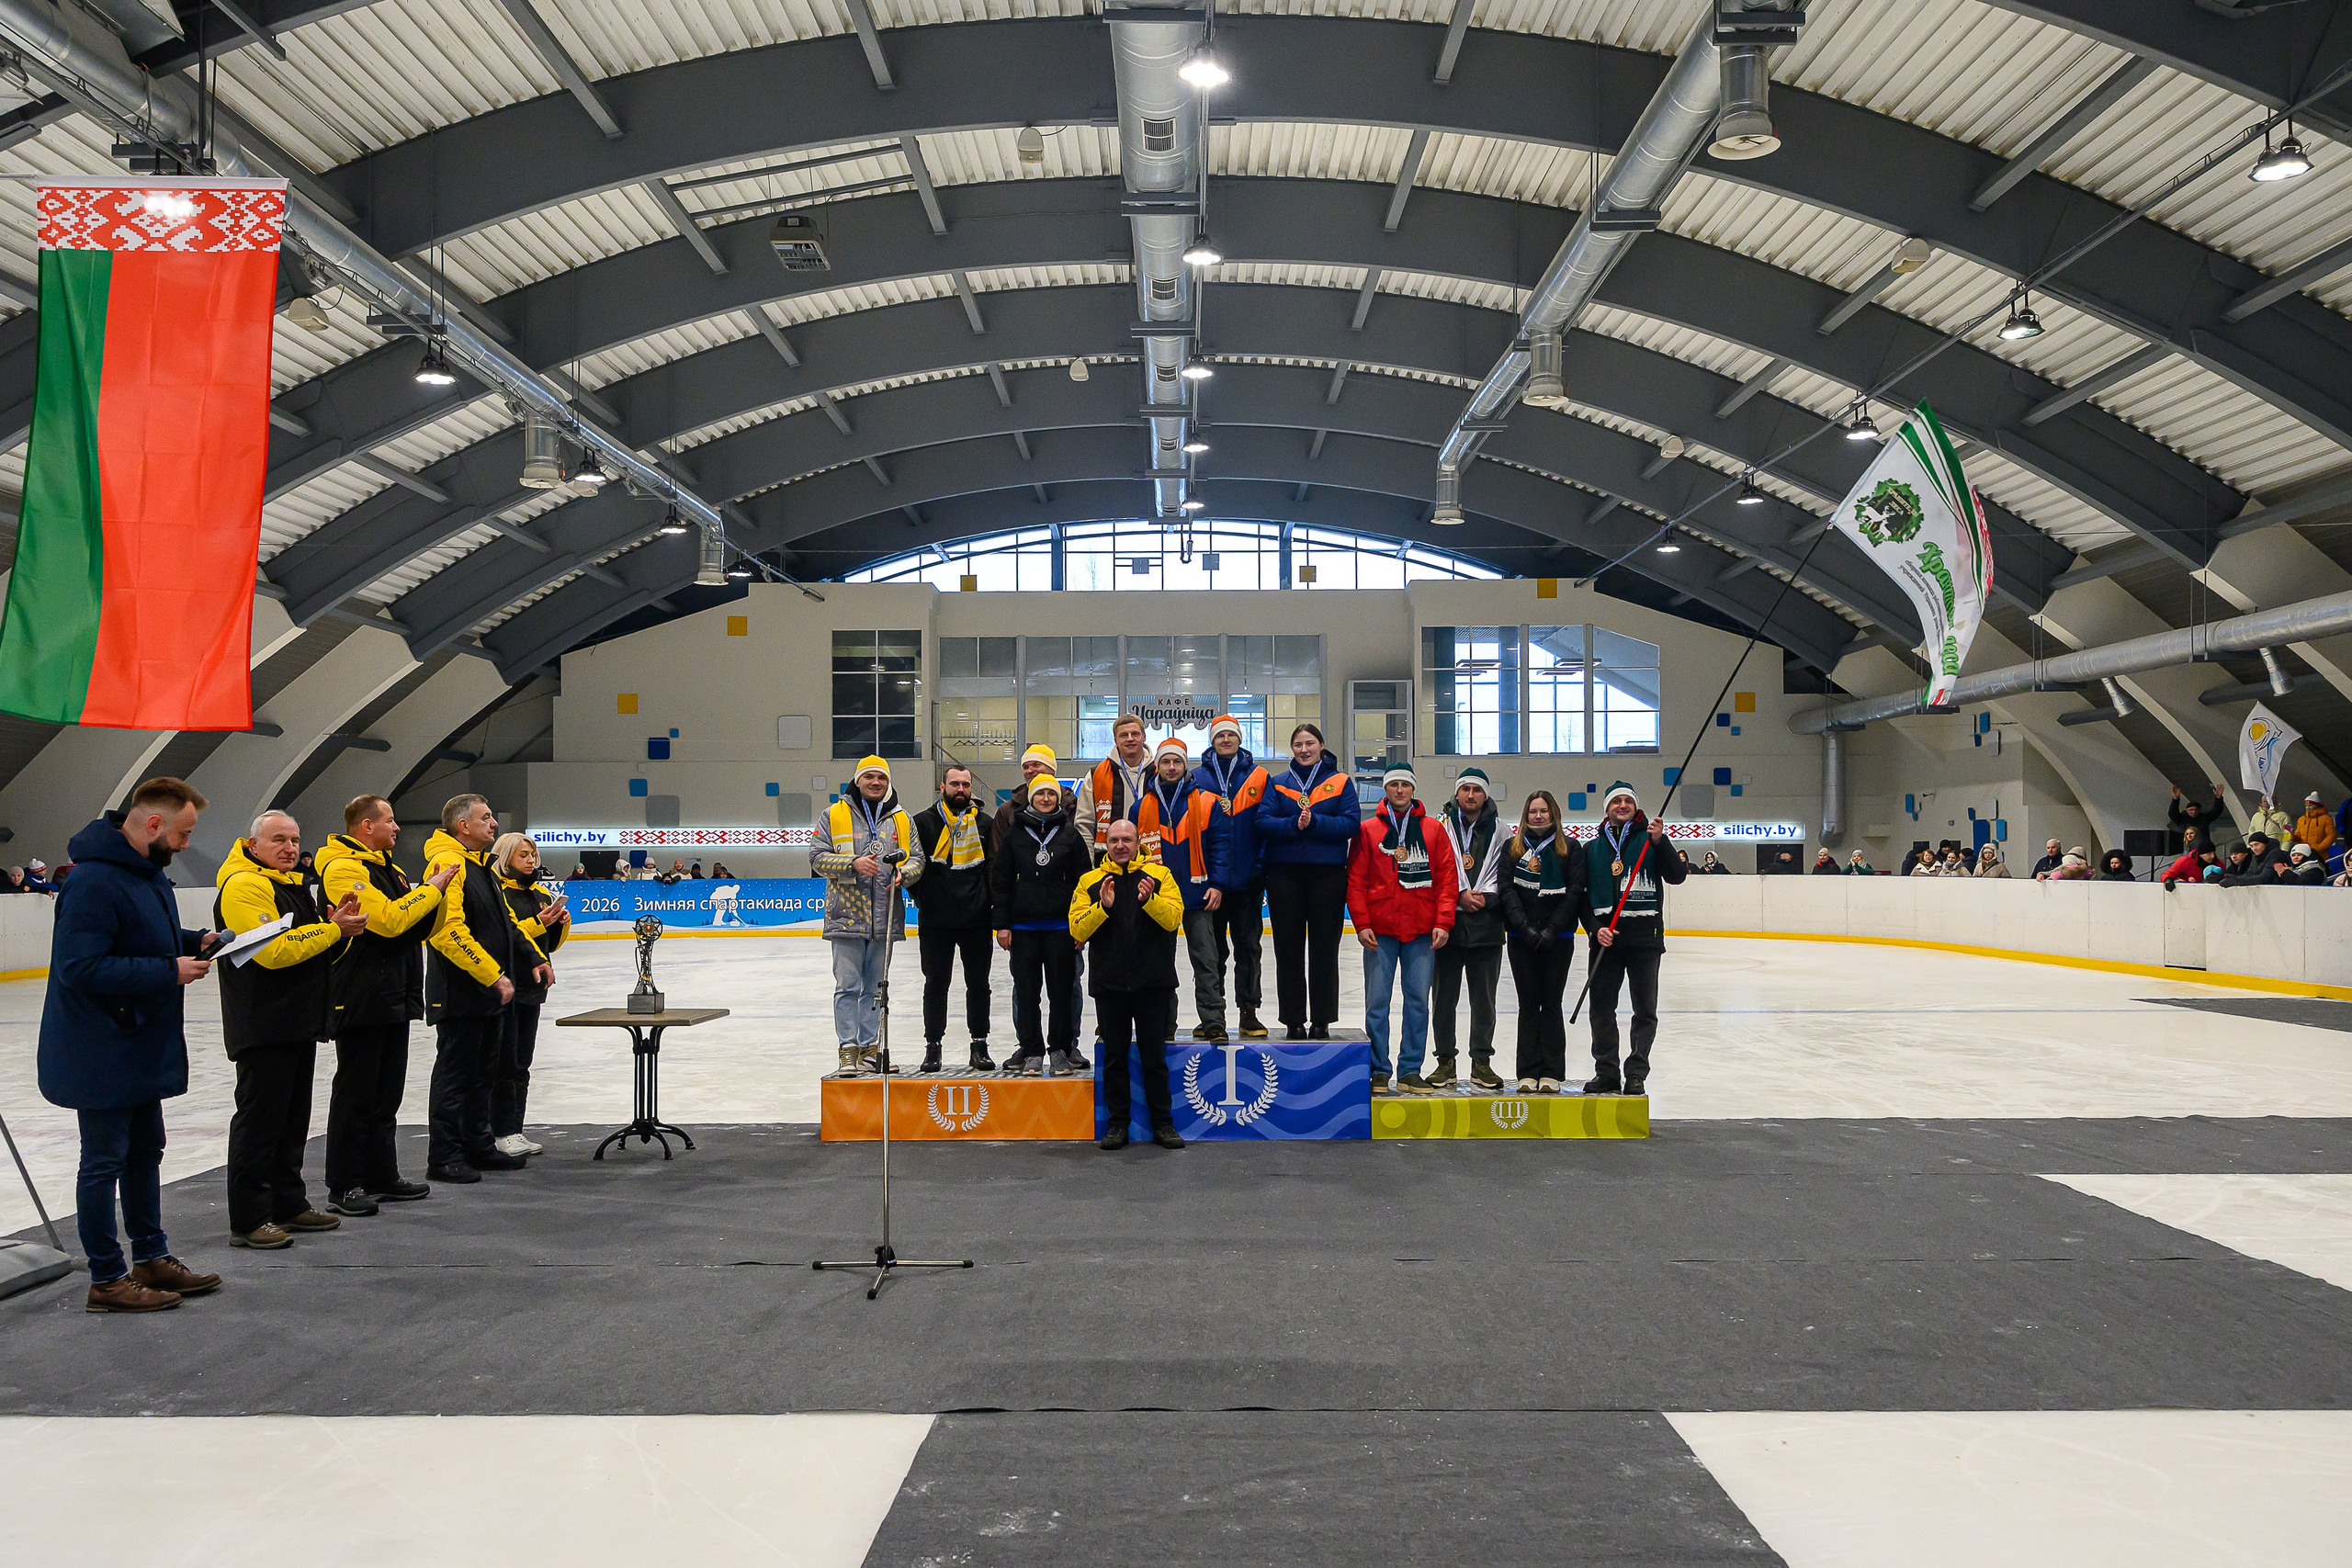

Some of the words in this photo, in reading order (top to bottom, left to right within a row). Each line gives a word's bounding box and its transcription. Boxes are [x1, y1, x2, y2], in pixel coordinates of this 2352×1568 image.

[1158, 698, 1190, 706] КАФЕ
[534, 831, 606, 844] silichy.by
[1724, 824, 1797, 837] silichy.by
[581, 897, 620, 912] 2026
[634, 897, 695, 912] Зимняя
[699, 897, 803, 913] спартакиада
[449, 930, 481, 965] BELARUS
[944, 1086, 973, 1116] II
